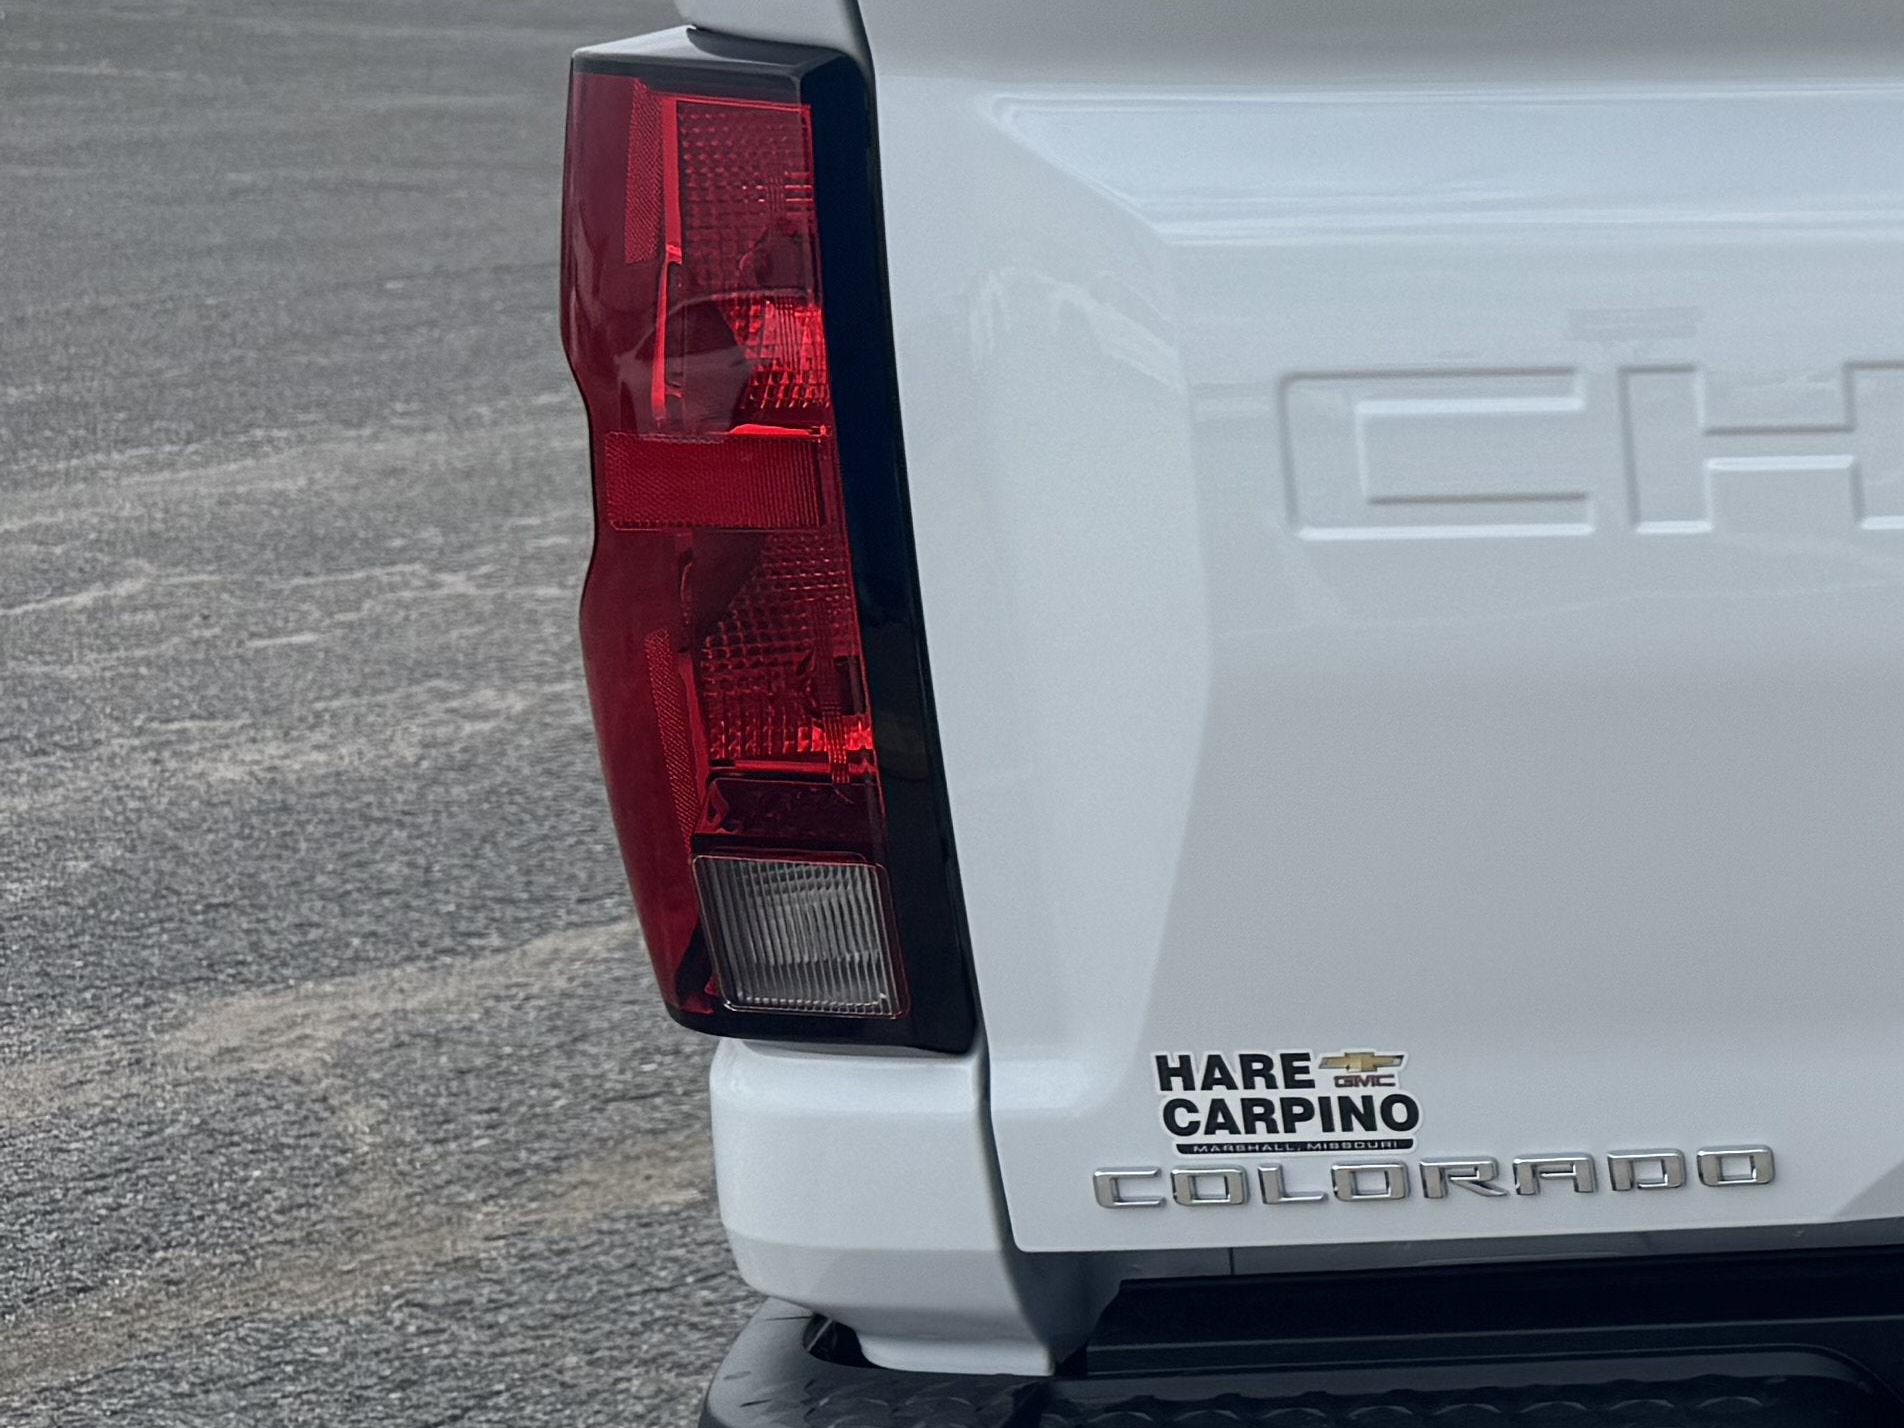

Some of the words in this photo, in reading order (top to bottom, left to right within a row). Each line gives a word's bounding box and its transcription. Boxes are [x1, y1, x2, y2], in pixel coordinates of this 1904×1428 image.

[1155, 1052, 1316, 1091] HARE
[1334, 1074, 1396, 1088] GMC
[1162, 1093, 1420, 1138] CARPINO
[1193, 1143, 1303, 1153] MARSHALL,
[1306, 1141, 1399, 1151] MISSOURI
[1092, 1145, 1776, 1210] COLORADO
